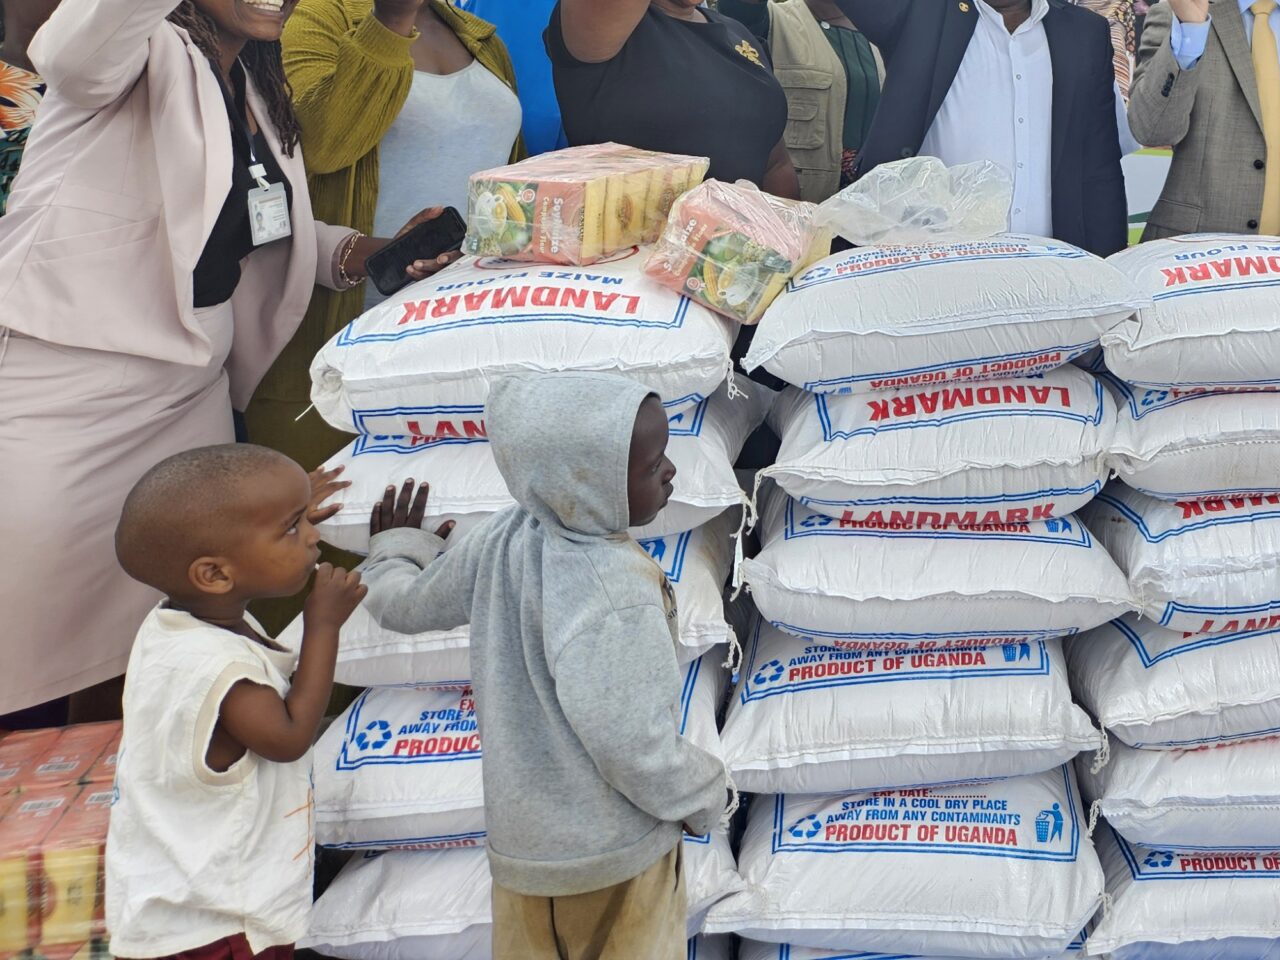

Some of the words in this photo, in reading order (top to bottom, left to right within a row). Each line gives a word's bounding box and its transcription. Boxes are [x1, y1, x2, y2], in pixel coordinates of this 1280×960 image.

[836, 254, 921, 275] PRODUCT
[929, 250, 950, 260] OF
[956, 246, 1030, 257] UGANDA
[1174, 244, 1247, 262] FLOUR
[435, 271, 528, 292] FLOUR
[536, 270, 623, 285] MAIZE
[398, 285, 641, 326] LANDMARK
[952, 366, 973, 378] OF
[979, 352, 1061, 377] PRODUCT
[870, 371, 947, 388] UGANDA
[867, 385, 1071, 421] LANDMARK
[842, 503, 1055, 528] LANDMARK
[789, 652, 823, 667] AWAY
[828, 649, 862, 661] FROM
[789, 659, 876, 682] PRODUCT
[882, 657, 906, 671] OF
[911, 651, 987, 669] UGANDA
[420, 708, 464, 722] STORE
[397, 721, 441, 736] AWAY
[393, 733, 480, 757] PRODUC
[842, 797, 879, 811] STORE
[883, 797, 895, 808] IN
[899, 797, 907, 808] A
[911, 797, 941, 809] COOL
[944, 798, 969, 810] DRY
[972, 799, 1008, 811] PLACE
[826, 810, 861, 824] AWAY
[865, 809, 899, 821] FROM
[902, 810, 928, 822] ANY
[931, 811, 1021, 826] CONTAMINANTS
[825, 823, 911, 842] PRODUCT
[917, 824, 940, 841] OF
[944, 825, 1018, 846] UGANDA
[1179, 855, 1257, 872] PRODUCT
